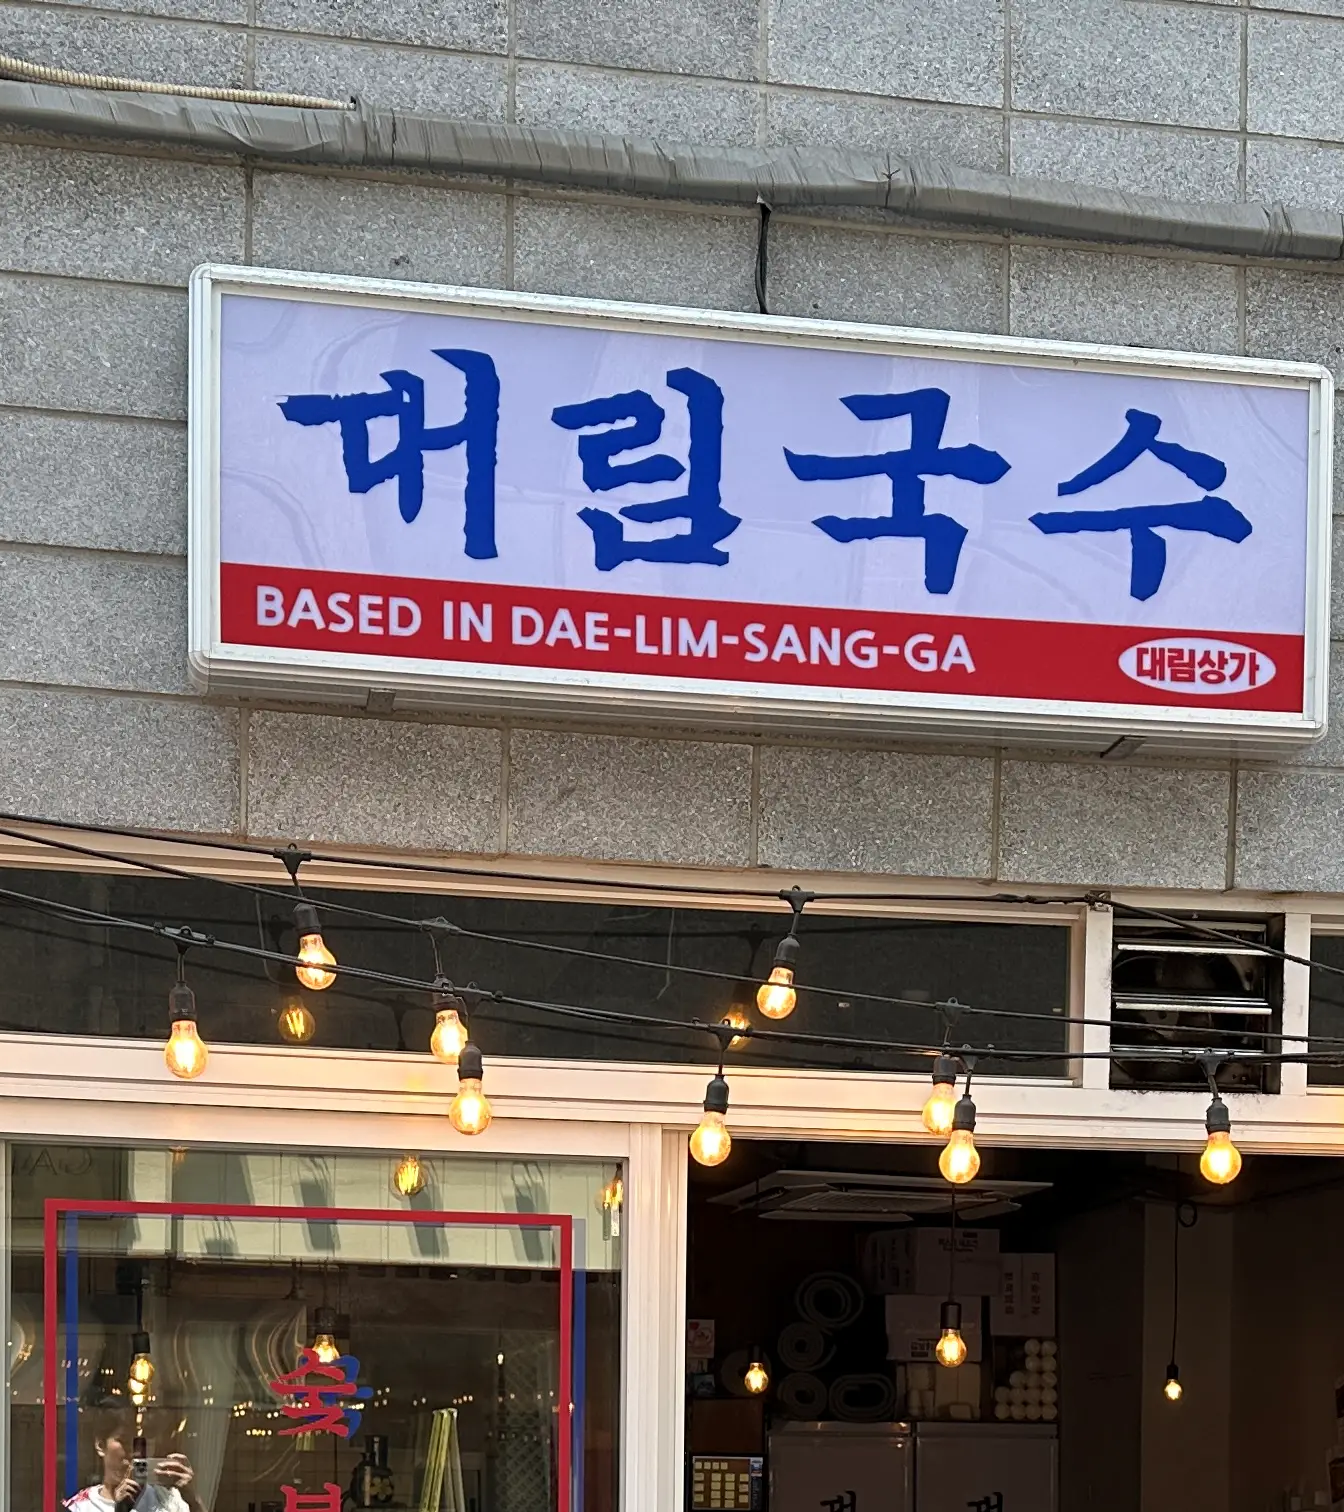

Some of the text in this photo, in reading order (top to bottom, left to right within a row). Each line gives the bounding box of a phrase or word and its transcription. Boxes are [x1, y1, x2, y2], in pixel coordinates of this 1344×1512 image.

[275, 347, 1253, 601] 대림국수
[255, 585, 977, 675] BASED IN DAE-LIM-SANG-GA
[1132, 641, 1264, 691] 대림상가
